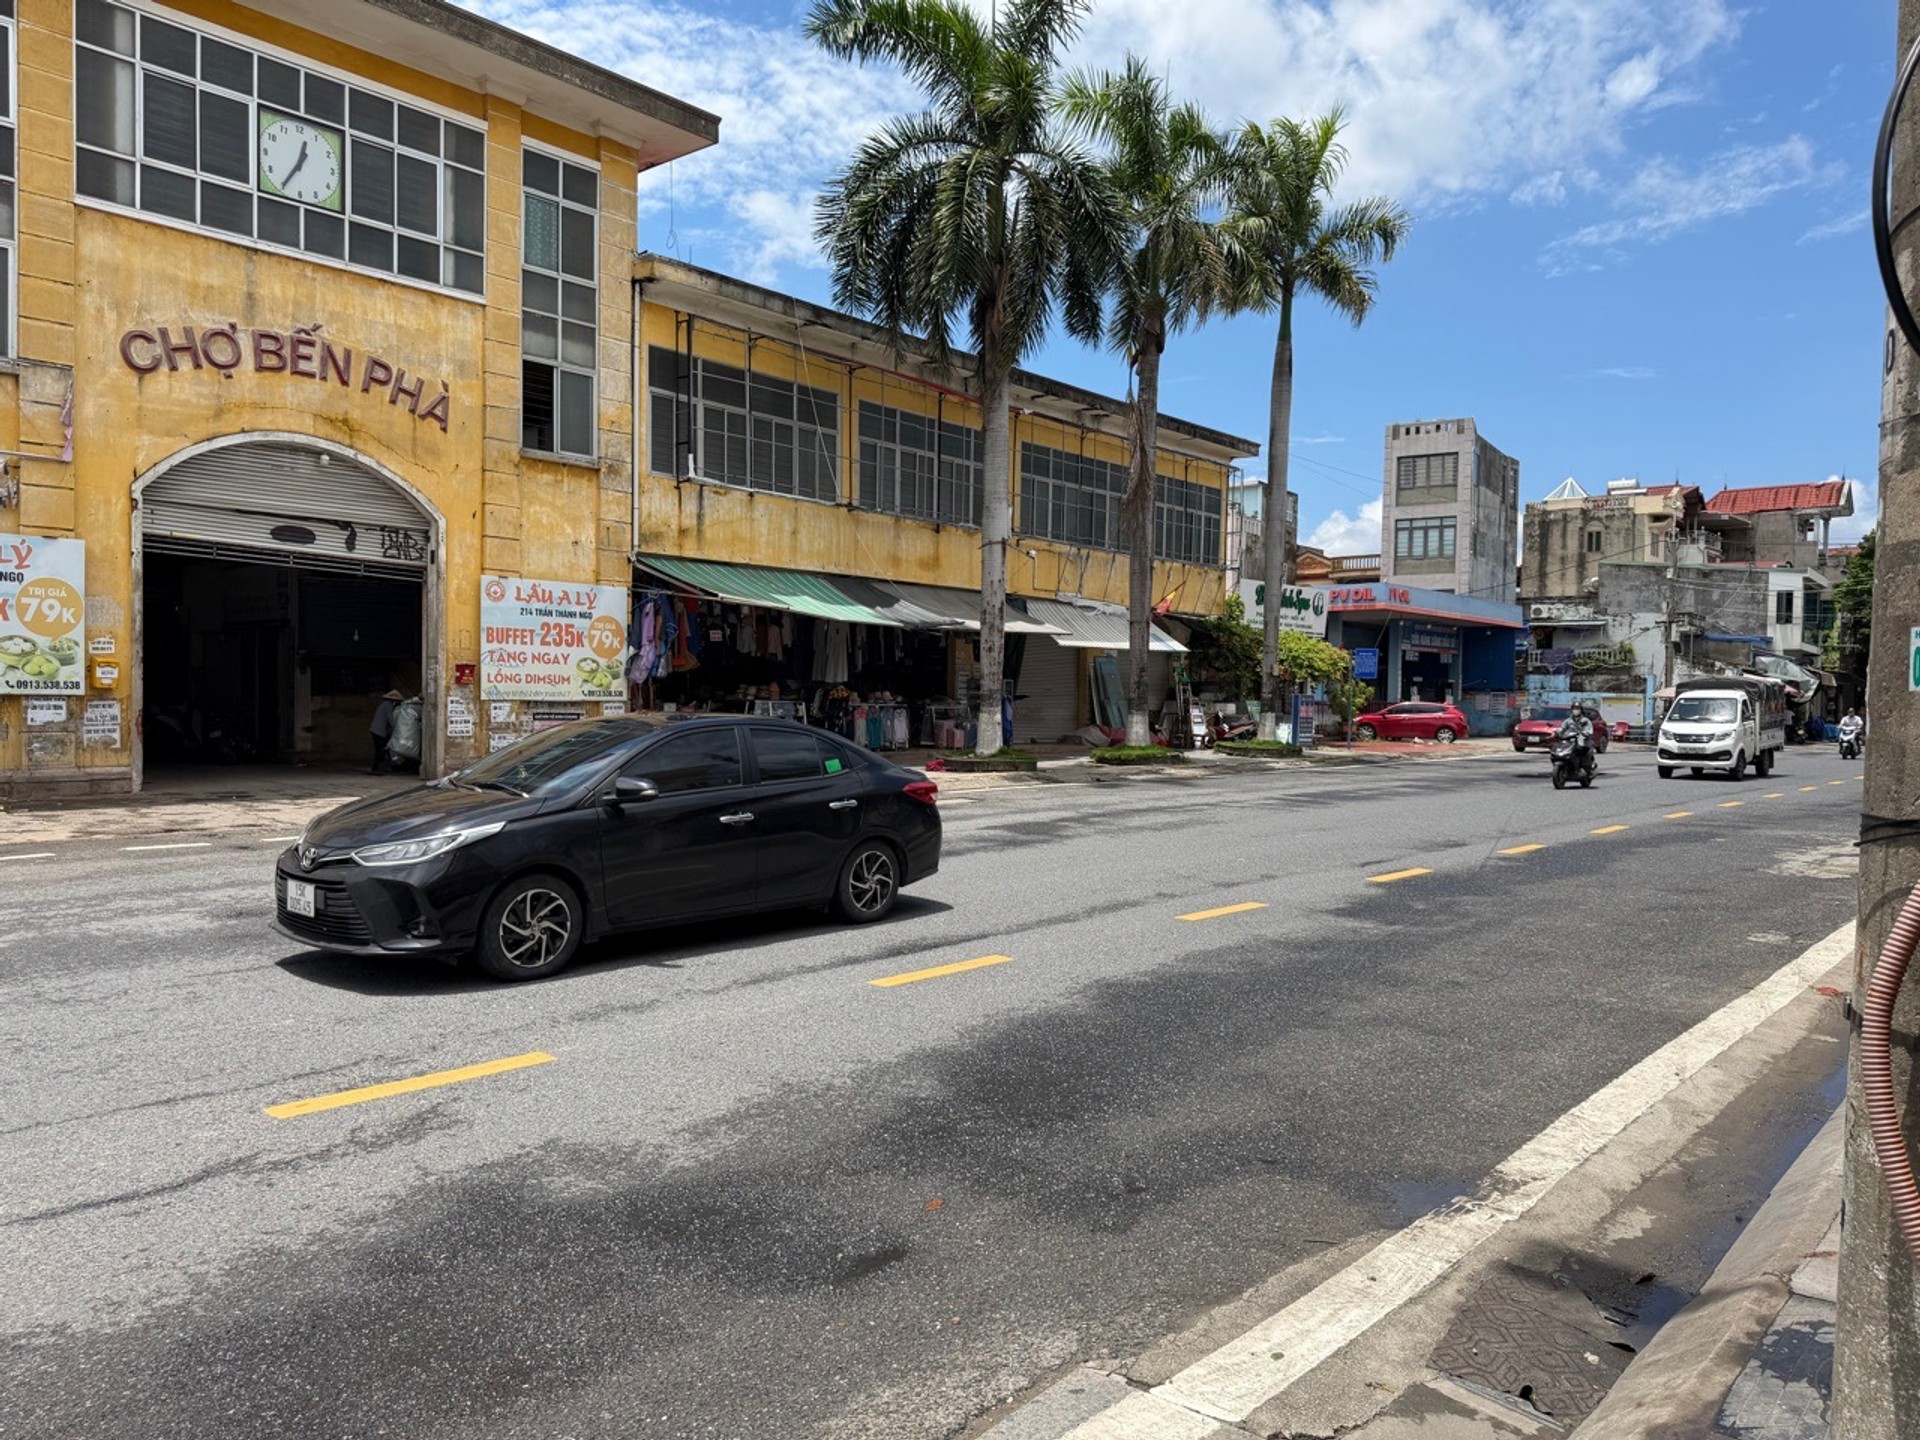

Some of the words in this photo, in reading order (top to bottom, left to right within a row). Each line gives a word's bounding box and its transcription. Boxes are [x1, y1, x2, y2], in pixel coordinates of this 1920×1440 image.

[119, 321, 243, 379] CHỢ
[252, 323, 352, 387] BẾN
[360, 355, 450, 434] PHÀ
[27, 586, 45, 598] TRỊ
[47, 587, 67, 597] GIÁ
[575, 588, 597, 610] LÝ
[21, 597, 76, 624] 79K
[520, 607, 533, 616] 214
[486, 627, 536, 646] BUFFET
[540, 621, 585, 648] 235K
[531, 652, 570, 665] NGAY
[16, 680, 81, 690] 0913.538.538
[525, 673, 571, 685] DIMSUM
